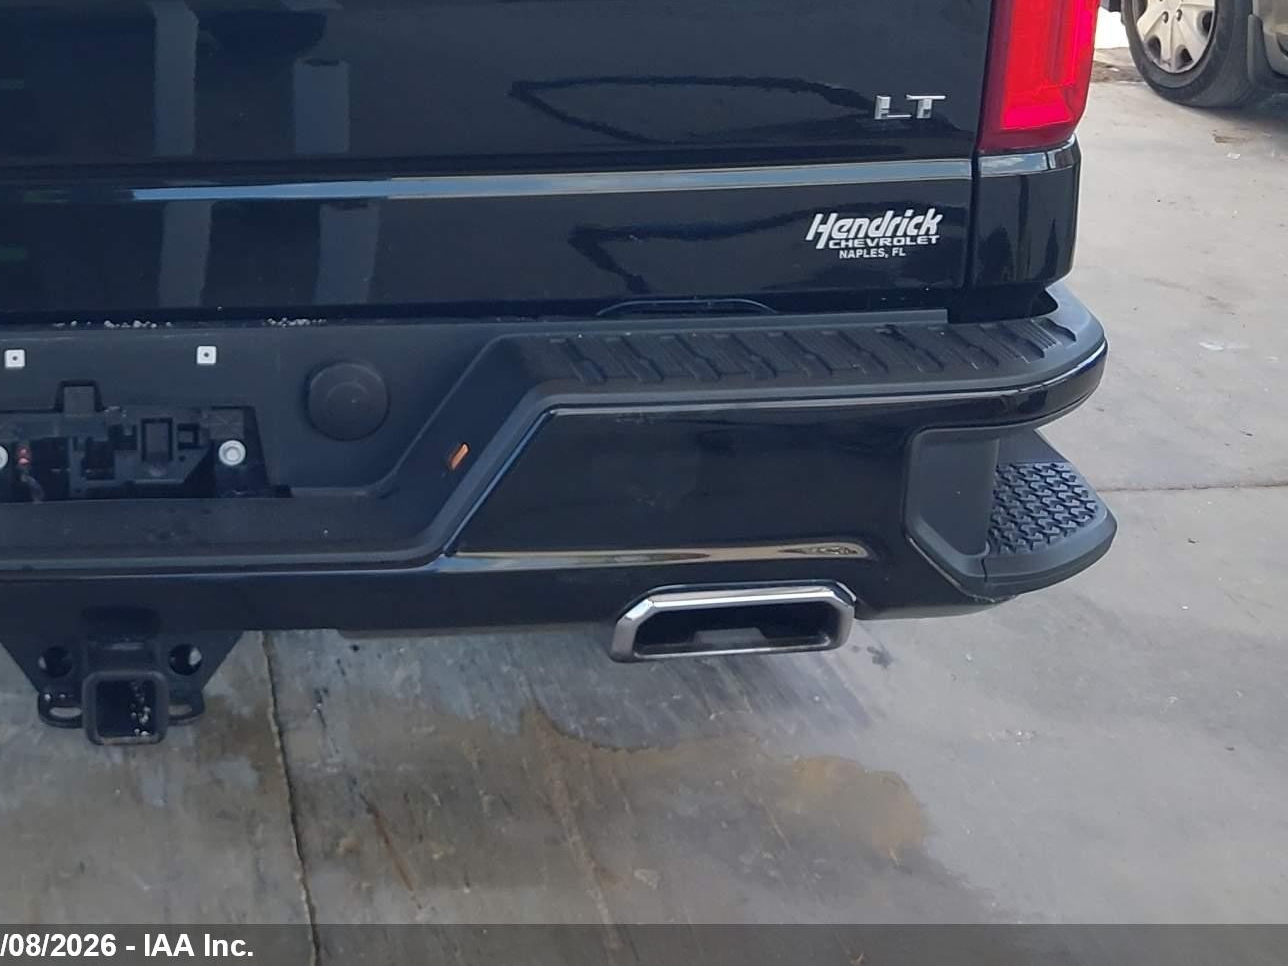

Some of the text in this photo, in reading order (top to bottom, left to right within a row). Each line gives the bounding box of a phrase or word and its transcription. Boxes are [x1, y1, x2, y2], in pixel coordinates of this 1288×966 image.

[874, 94, 946, 120] LT
[805, 208, 943, 249] Hendrick
[828, 235, 940, 249] CHEVROLET
[839, 247, 906, 259] NAPLES, FL
